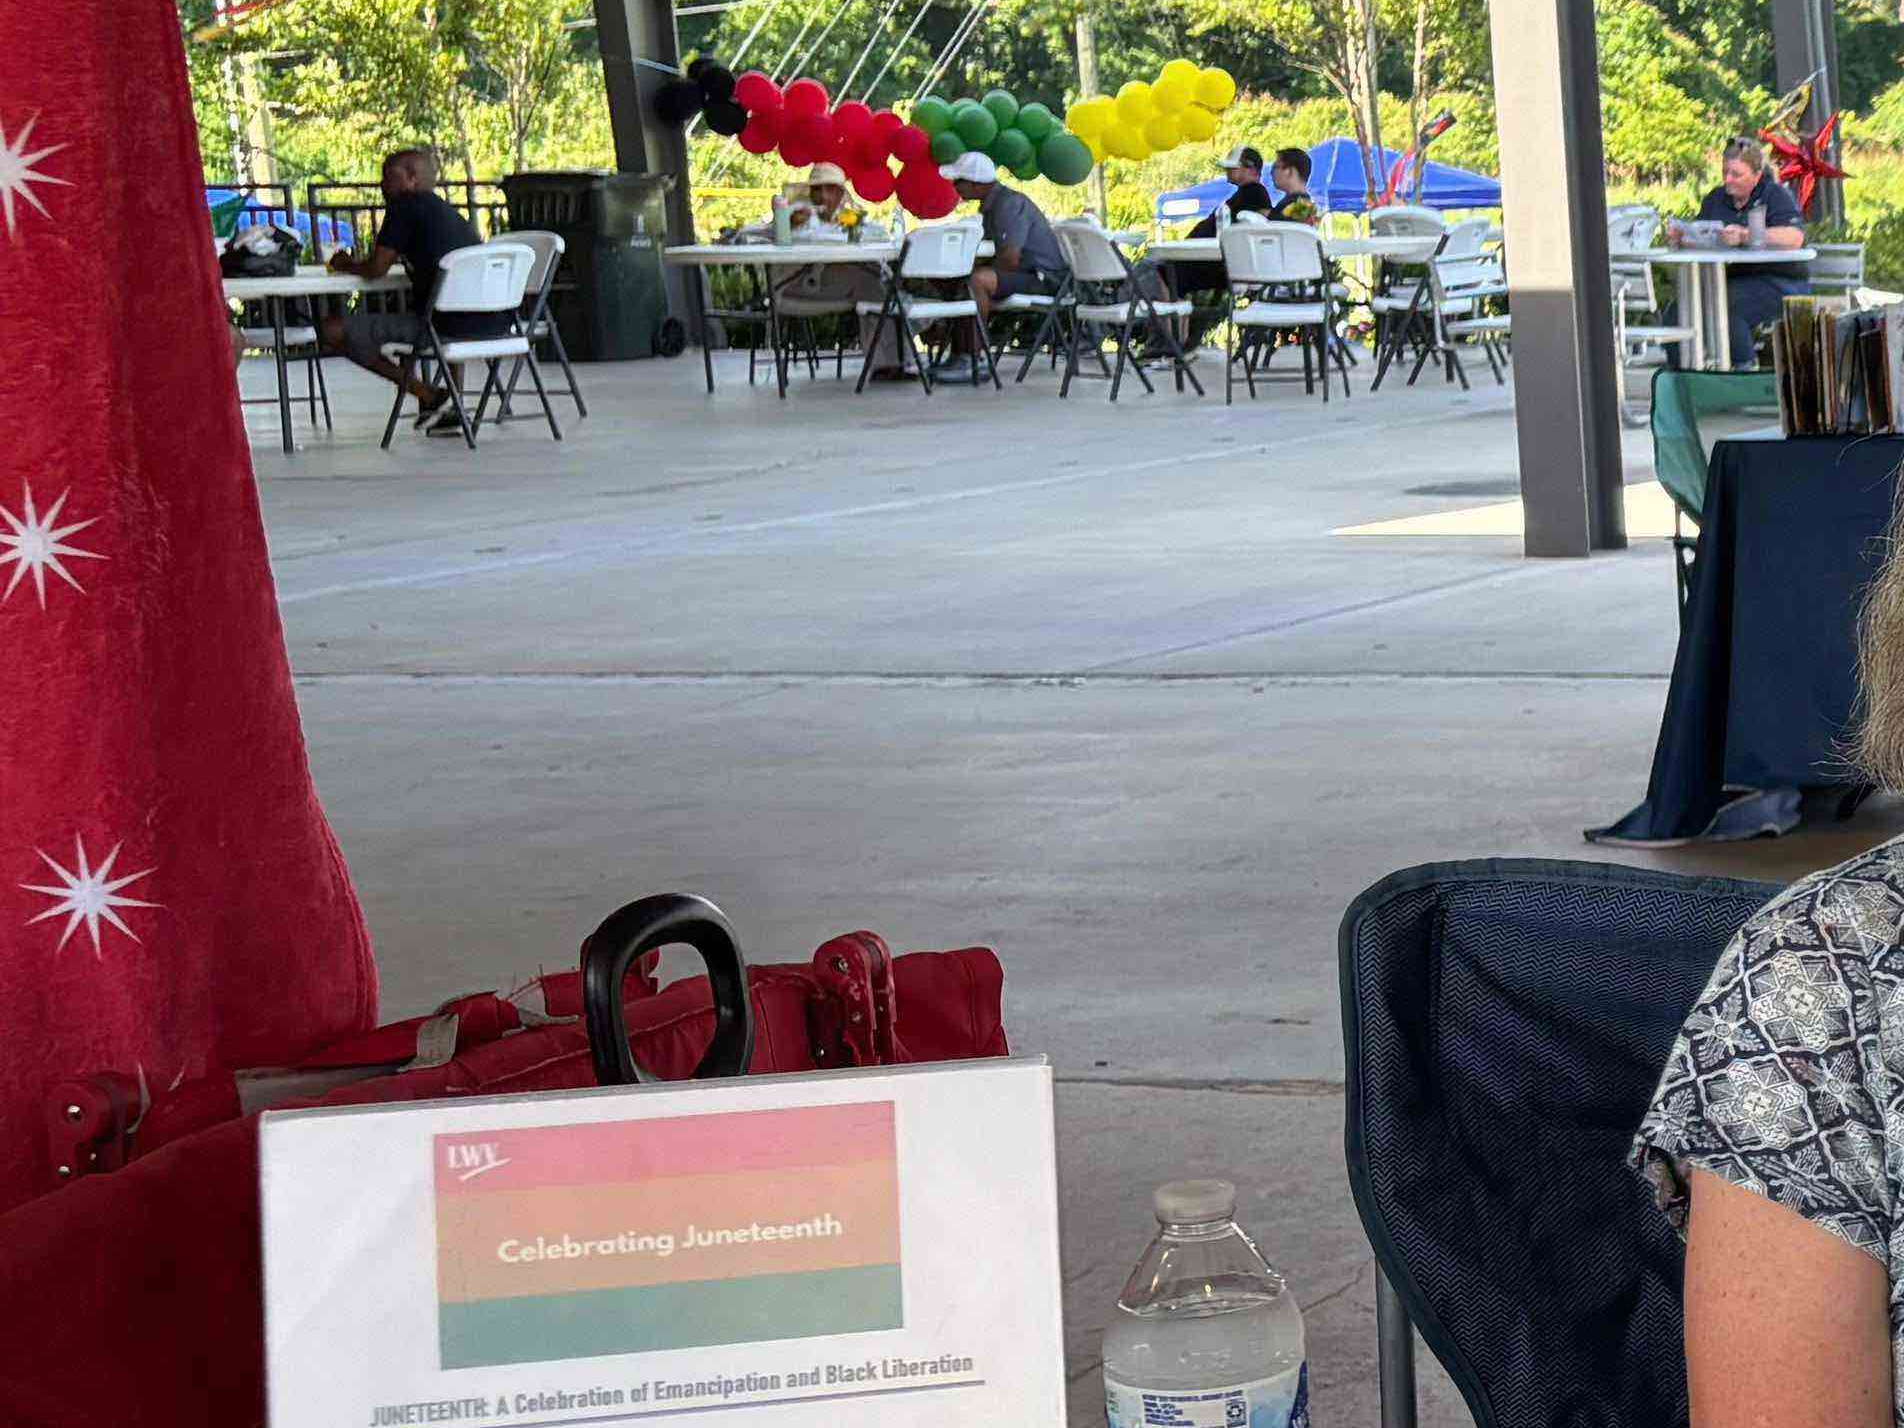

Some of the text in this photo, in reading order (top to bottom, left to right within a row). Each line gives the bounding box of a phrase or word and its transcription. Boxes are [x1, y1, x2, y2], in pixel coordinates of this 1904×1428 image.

[447, 1142, 501, 1169] LWV
[497, 1212, 843, 1264] Celebrating Juneteenth
[370, 1354, 973, 1428] JUNETEENTH: A Celebration of Emancipation and Black Liberation
